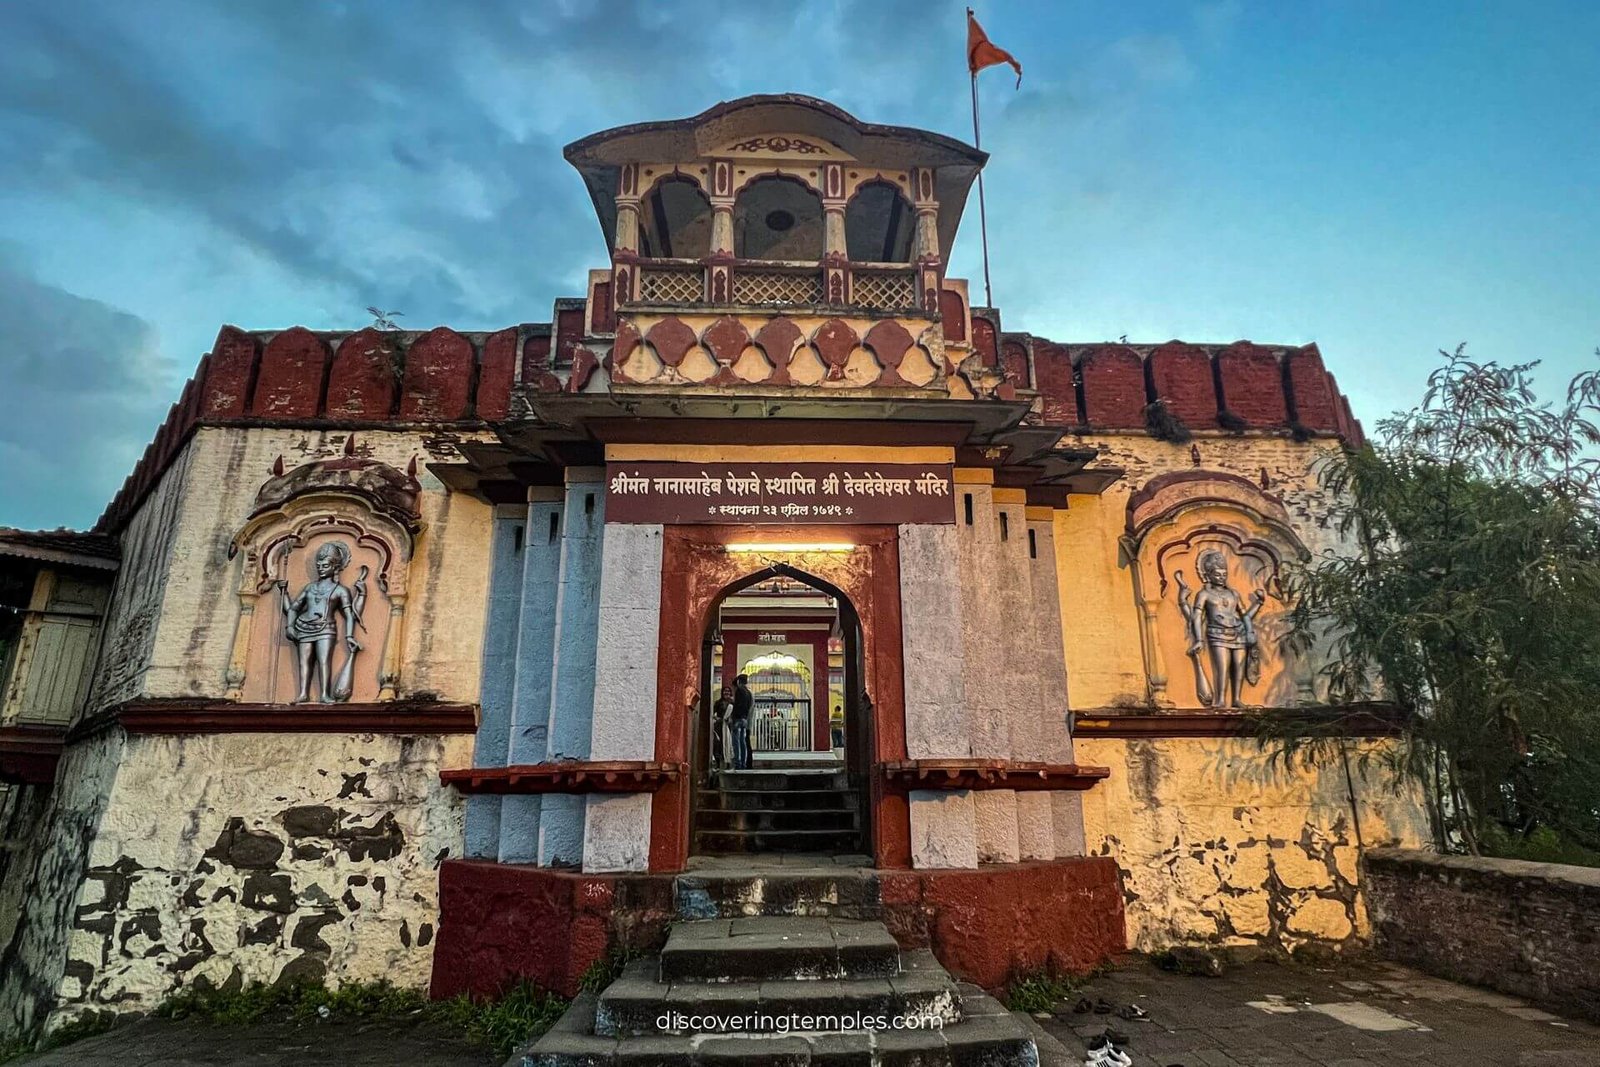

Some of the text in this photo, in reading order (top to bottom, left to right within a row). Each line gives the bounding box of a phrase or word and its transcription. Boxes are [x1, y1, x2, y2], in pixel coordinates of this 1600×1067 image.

[610, 471, 949, 497] श्रीमंत नानासाहेब पेशवे स्थापित श्री देवदेवेश्वर मंदिर
[719, 503, 842, 518] स्थापना २३ एप्रिल १७४९
